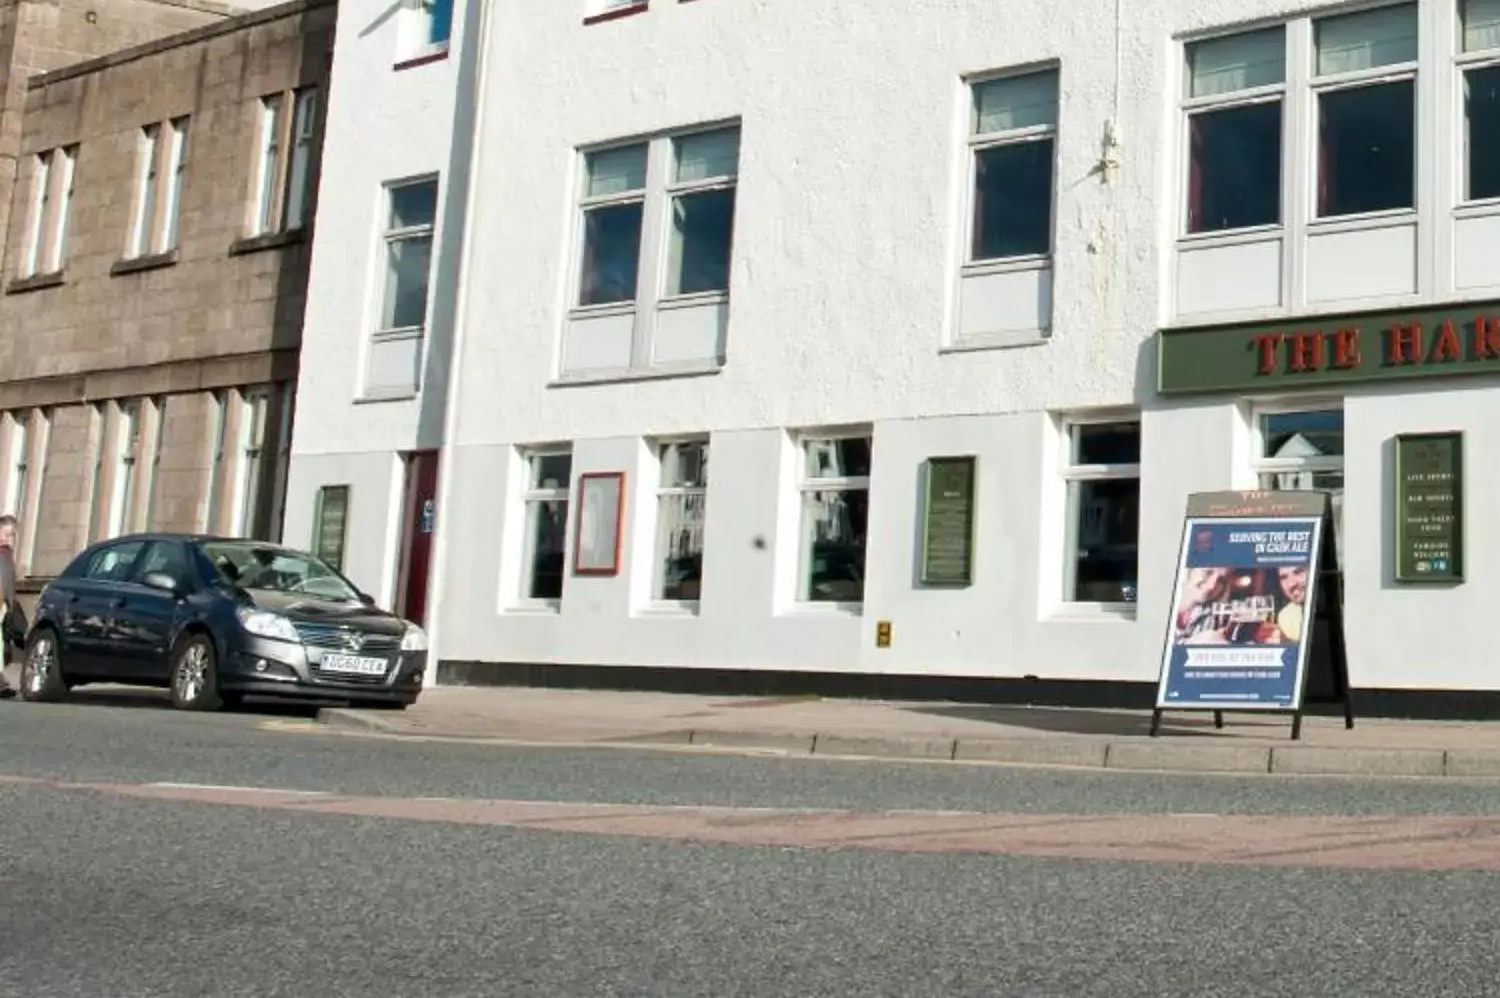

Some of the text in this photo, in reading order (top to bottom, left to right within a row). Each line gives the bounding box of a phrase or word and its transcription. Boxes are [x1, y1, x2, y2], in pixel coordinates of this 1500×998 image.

[1253, 328, 1361, 375] THE
[1229, 532, 1311, 543] SERVING THE BEST
[1255, 544, 1265, 553] IN
[1290, 542, 1309, 553] ALE
